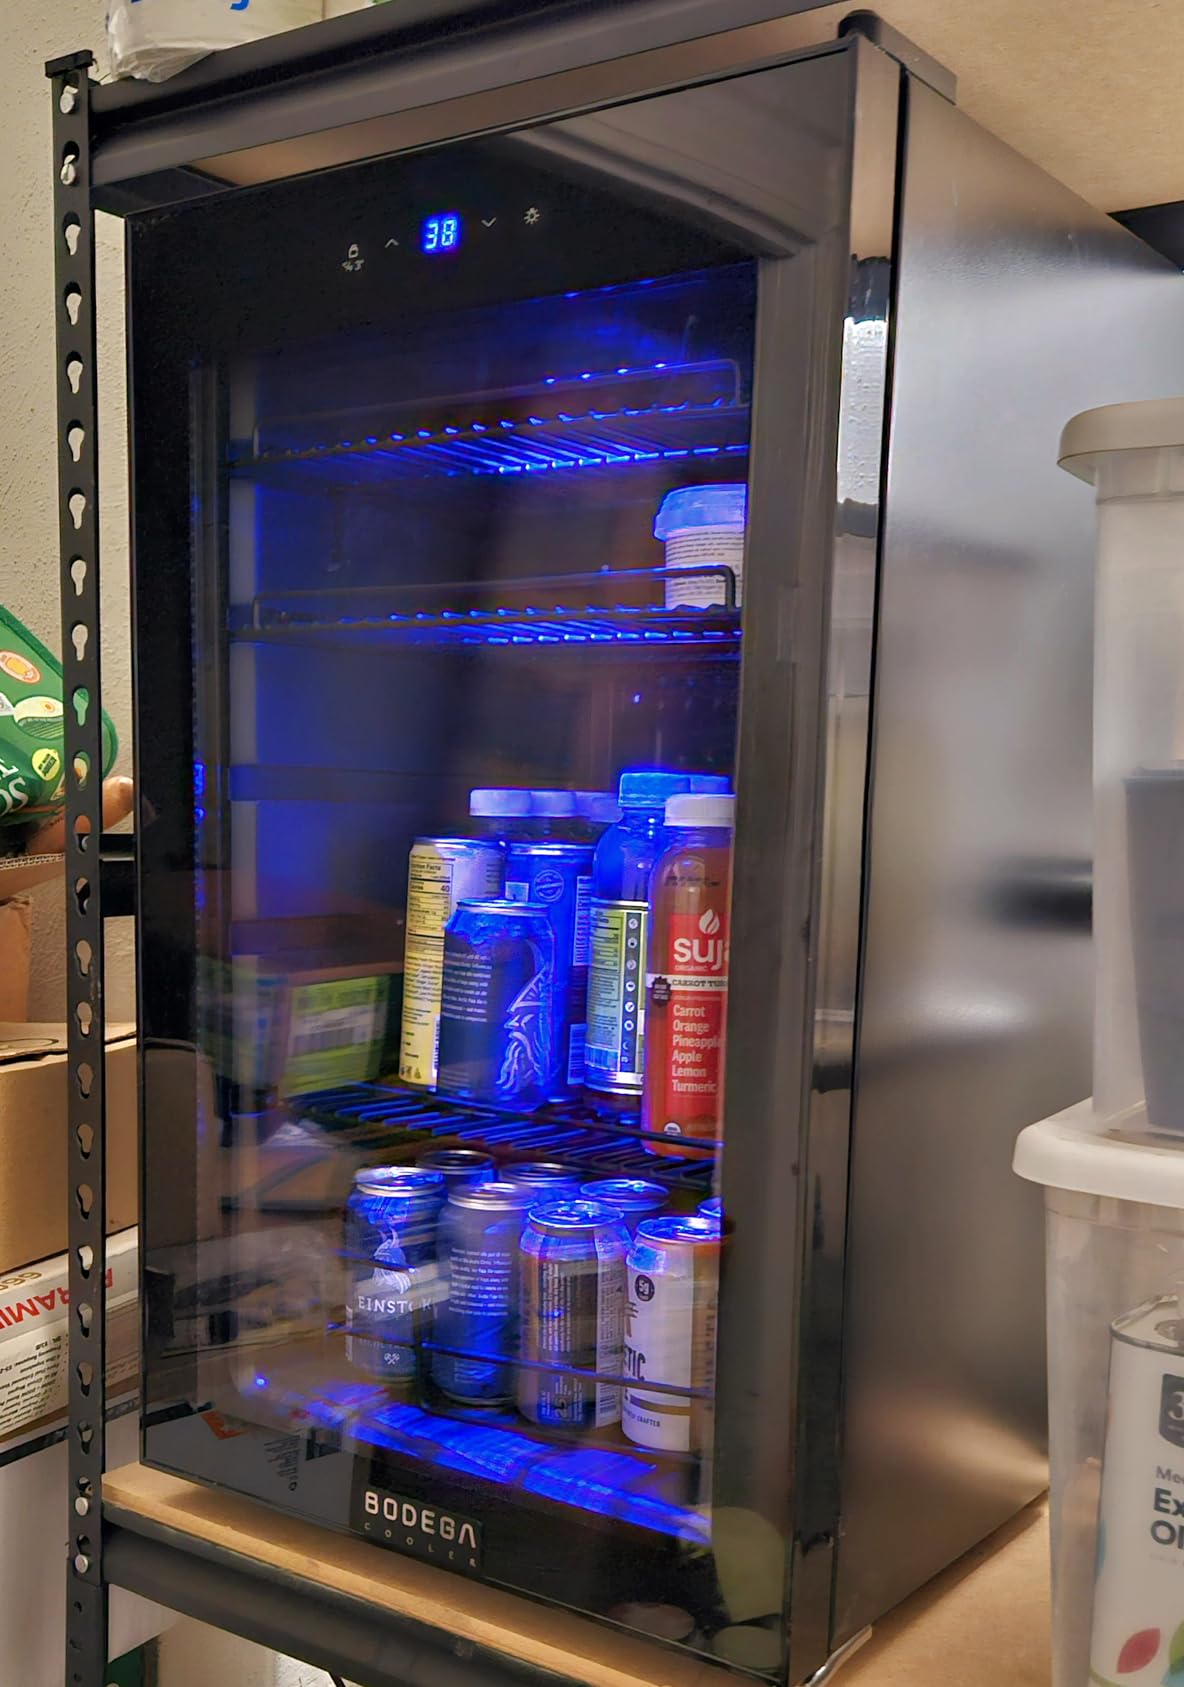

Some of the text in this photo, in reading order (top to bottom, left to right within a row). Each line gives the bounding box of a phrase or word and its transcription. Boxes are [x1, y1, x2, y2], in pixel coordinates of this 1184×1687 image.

[425, 218, 456, 249] 38
[673, 937, 729, 971] suj
[673, 1004, 706, 1017] Carrot
[673, 1019, 710, 1034] Orange
[672, 1049, 703, 1064] Apple
[672, 1064, 707, 1077] Lemon
[672, 1079, 718, 1093] Turmeric
[364, 1490, 477, 1549] BODEGA
